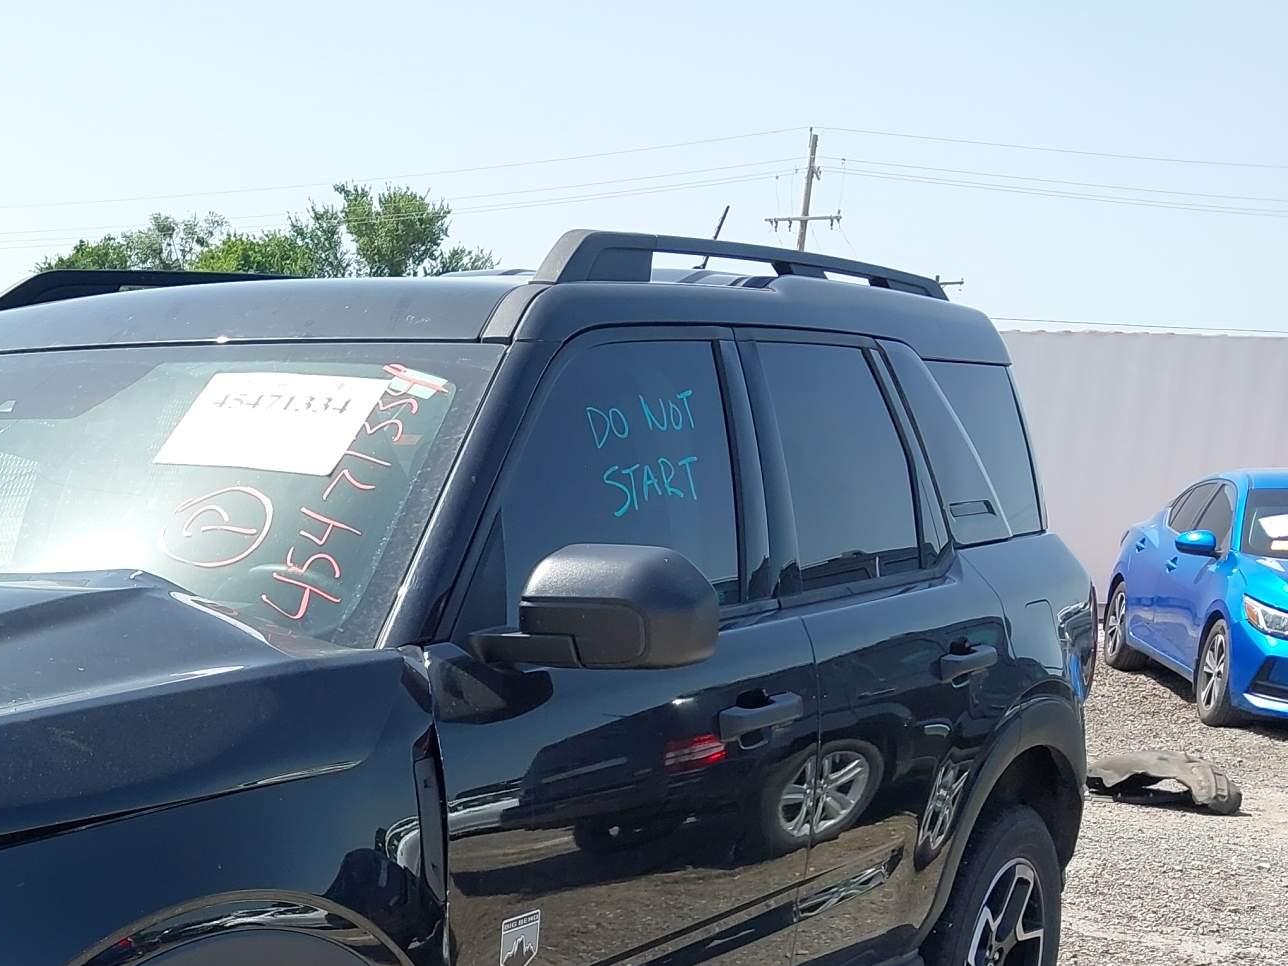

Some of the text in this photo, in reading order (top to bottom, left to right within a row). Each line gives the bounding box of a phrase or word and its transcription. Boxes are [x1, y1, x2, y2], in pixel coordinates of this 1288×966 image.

[213, 393, 352, 414] 45471334
[585, 389, 695, 449] DO NOT
[602, 456, 698, 517] START
[504, 914, 539, 930] BIG BEND
